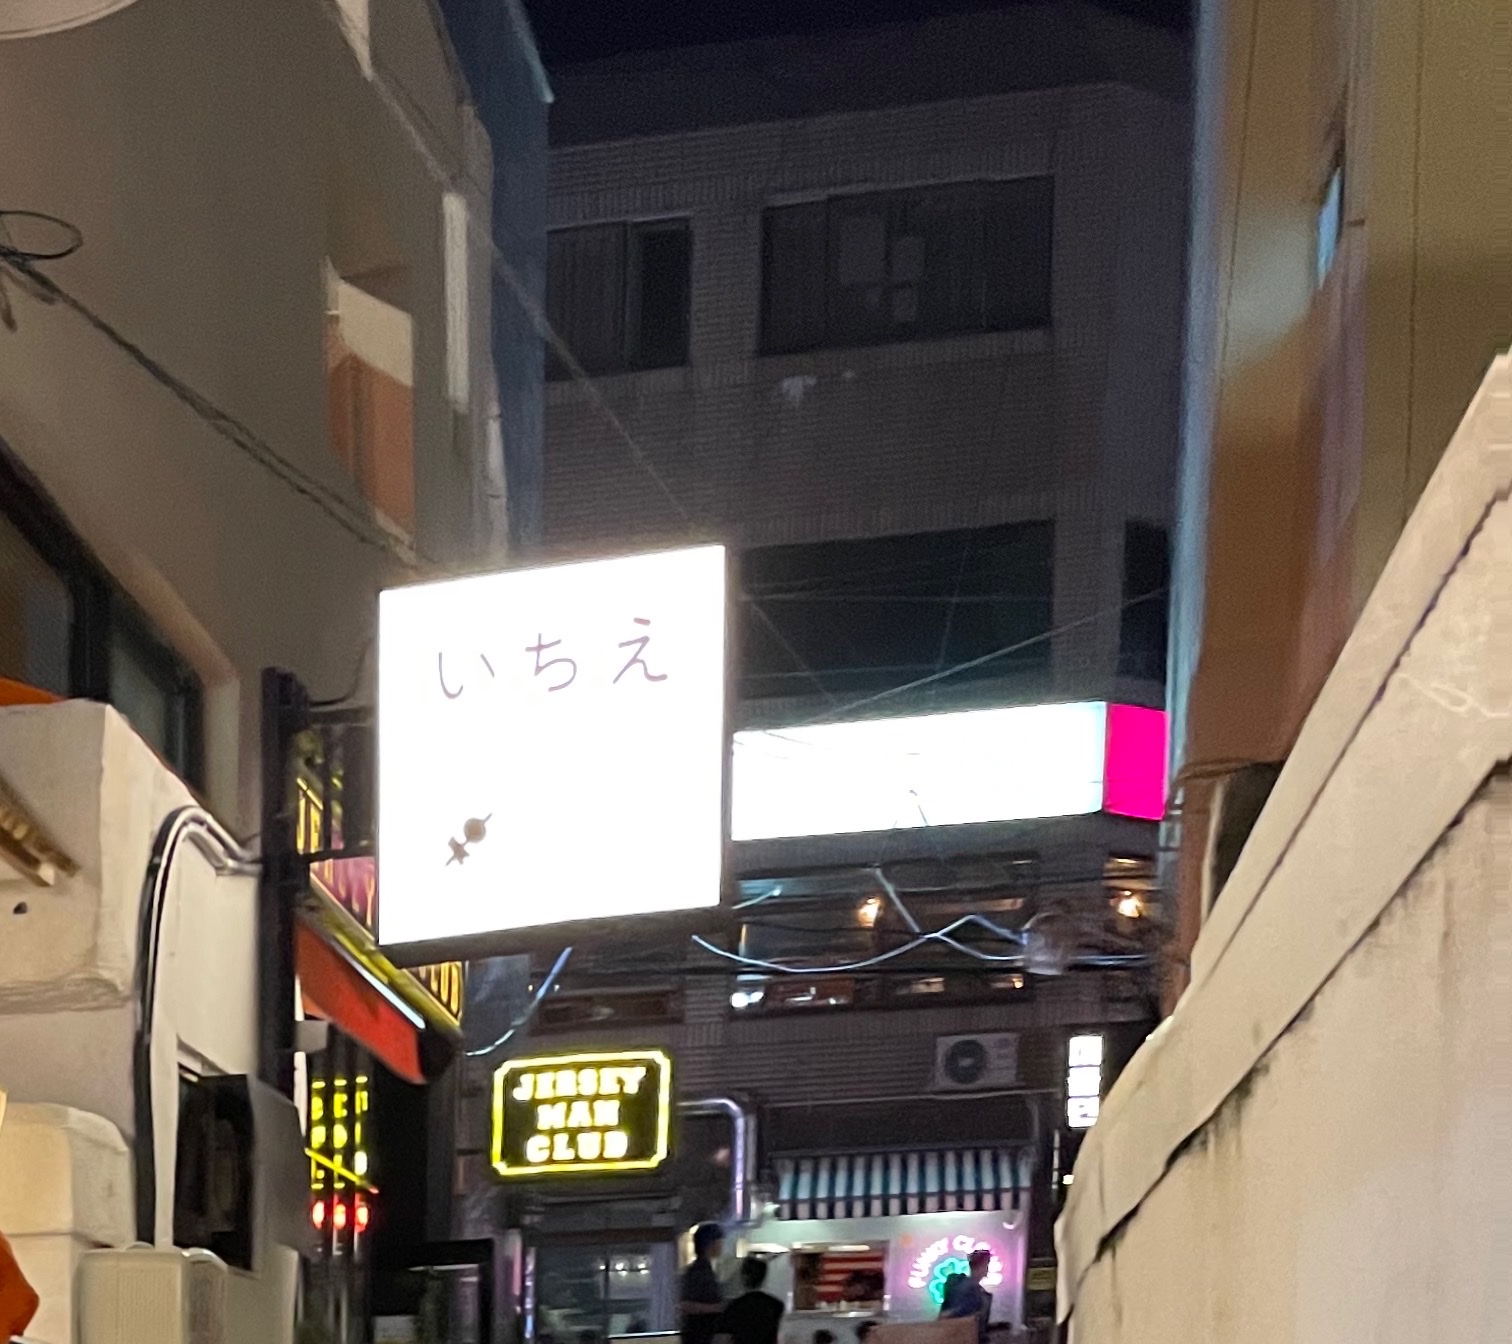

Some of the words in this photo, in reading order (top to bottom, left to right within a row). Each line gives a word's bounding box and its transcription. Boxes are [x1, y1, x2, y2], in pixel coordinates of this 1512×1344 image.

[438, 617, 668, 699] いちえ
[512, 1066, 646, 1101] JERSEY
[537, 1099, 620, 1130] MAN
